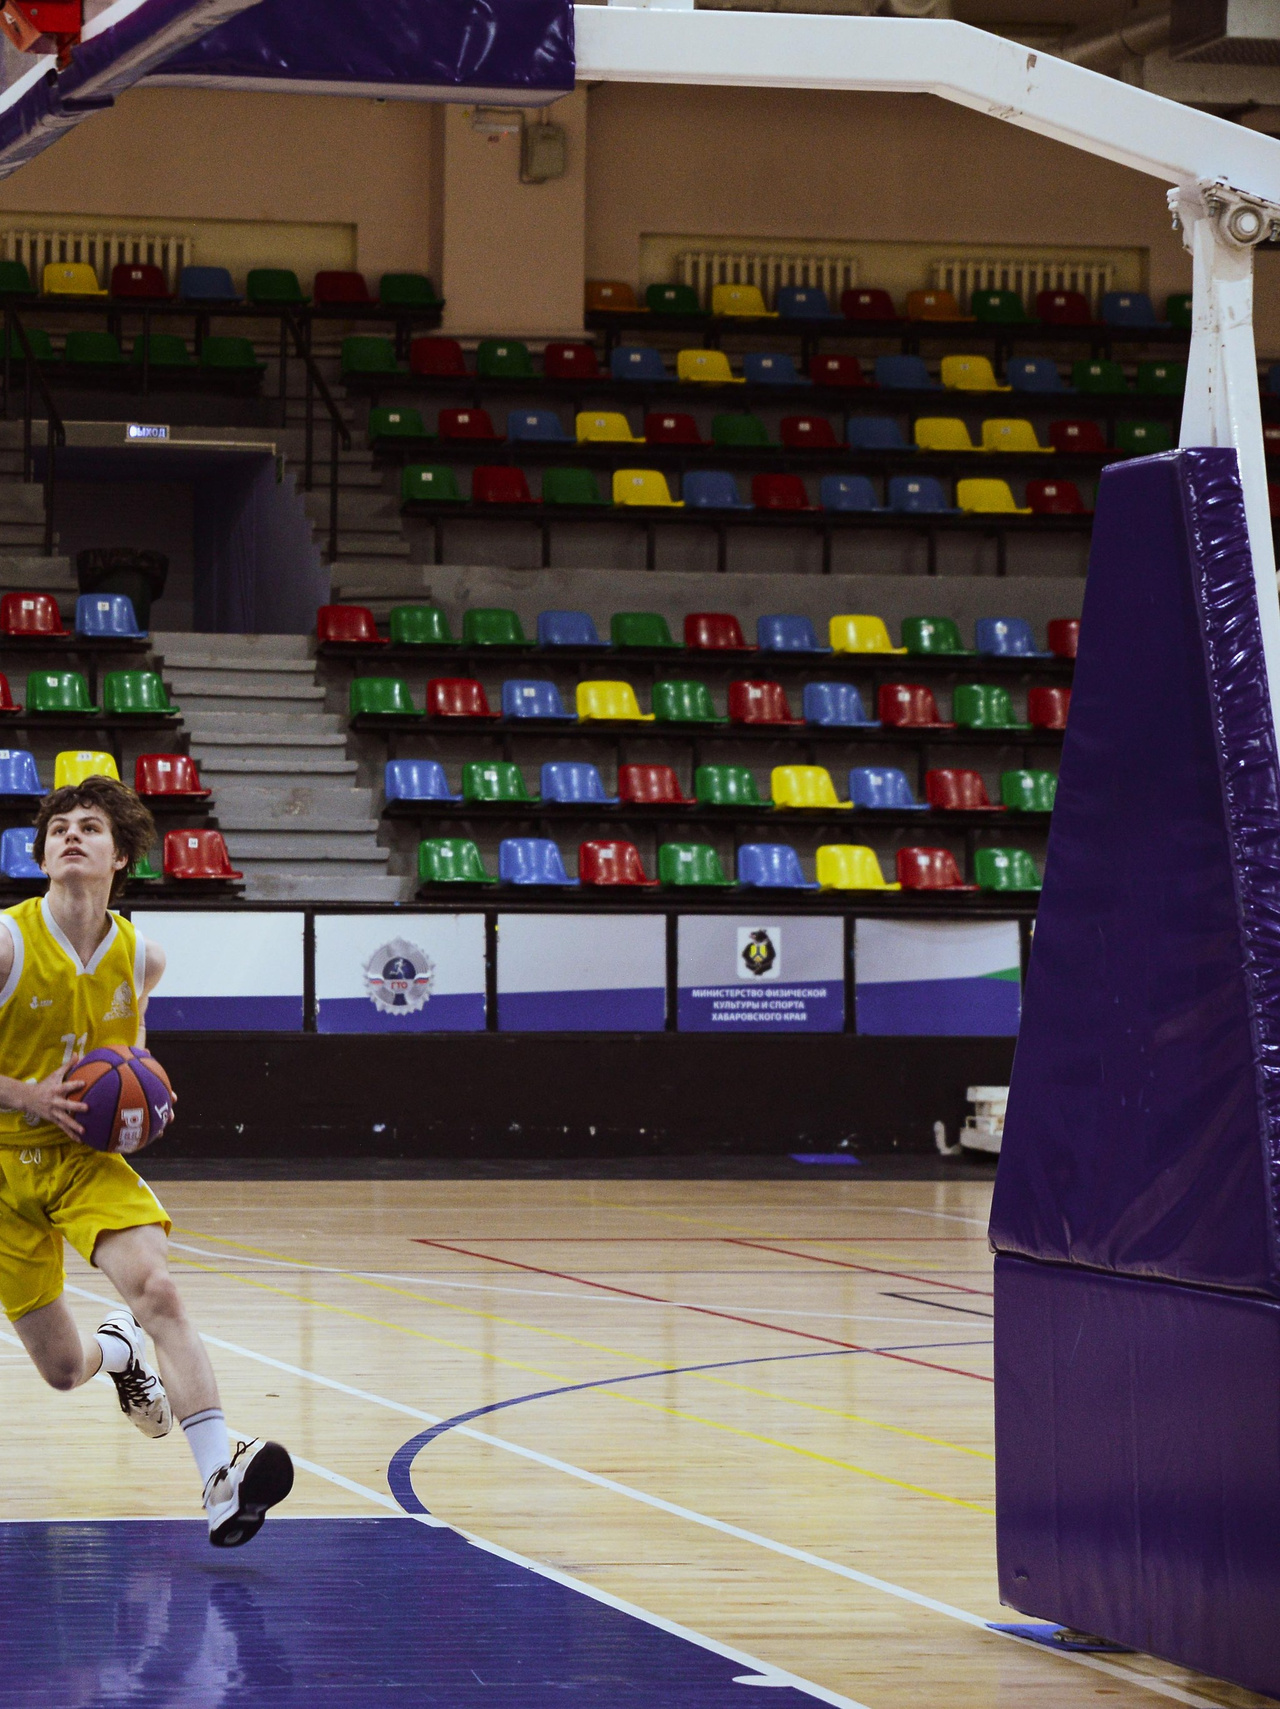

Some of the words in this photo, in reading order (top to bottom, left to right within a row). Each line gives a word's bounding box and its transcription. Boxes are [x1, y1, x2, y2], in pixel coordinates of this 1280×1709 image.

[692, 988, 764, 998] МИНИСТЕРСТВО
[765, 987, 827, 998] ФИЗИЧЕСКОЙ
[713, 1001, 760, 1009] КУЛЬТУРЫ
[761, 1001, 768, 1009] И
[769, 1001, 805, 1010] СПОРТА
[712, 1012, 782, 1022] ХАБАРОВСКОГО
[783, 1012, 807, 1022] КРАЯ
[60, 1031, 88, 1066] 11
